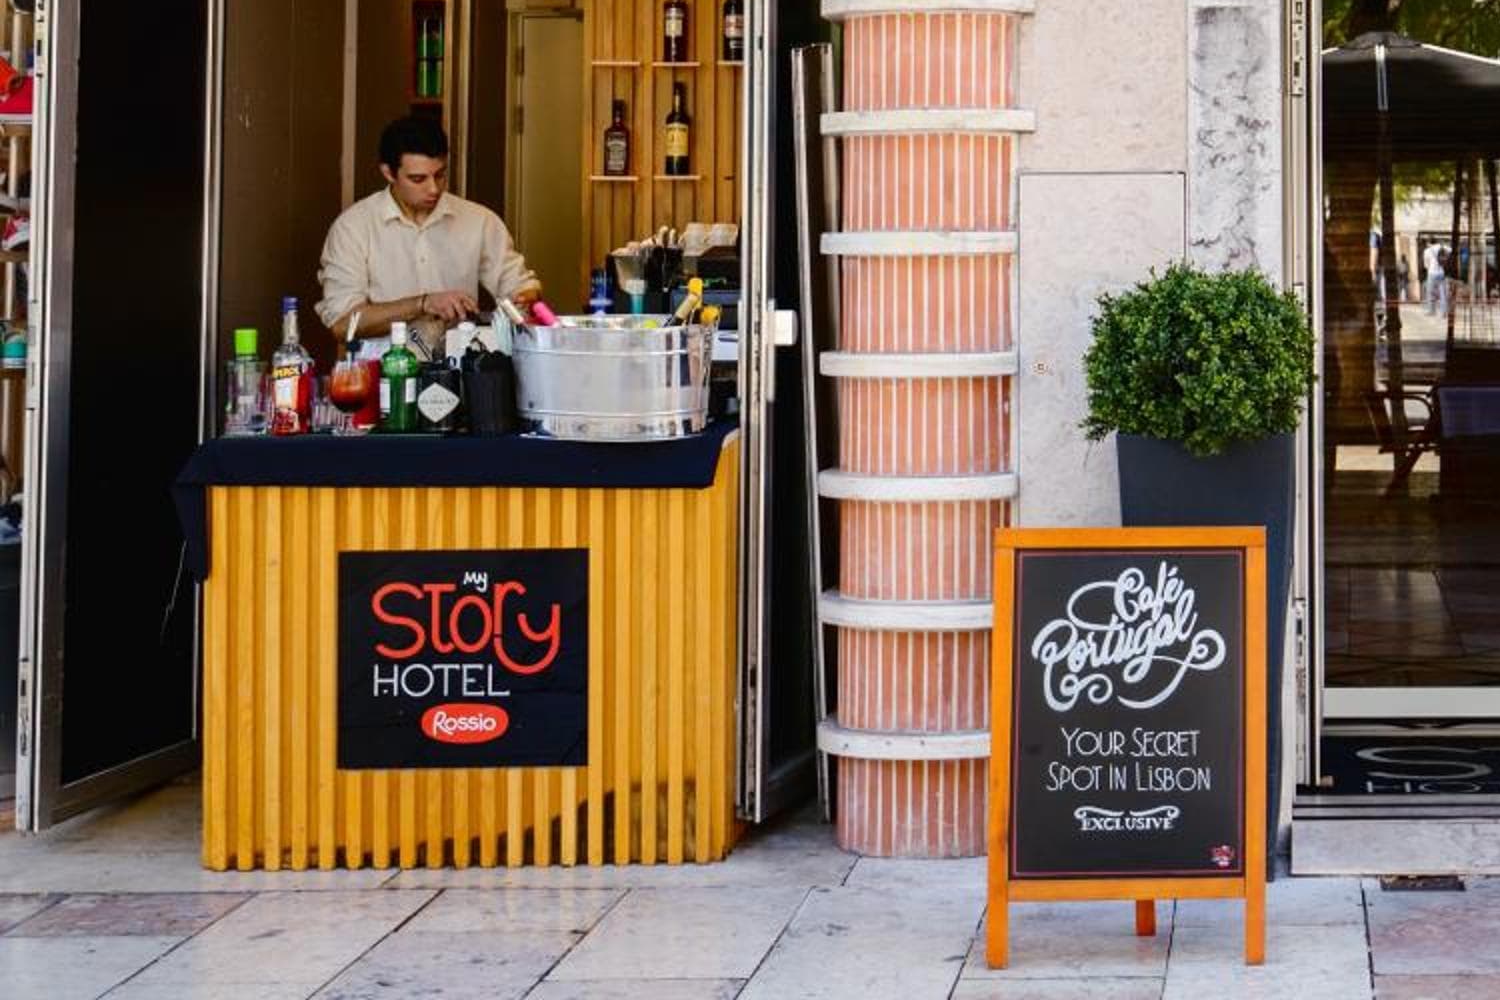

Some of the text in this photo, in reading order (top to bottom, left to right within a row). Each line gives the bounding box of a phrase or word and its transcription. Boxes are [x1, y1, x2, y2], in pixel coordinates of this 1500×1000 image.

[372, 581, 561, 675] Story
[373, 663, 511, 697] HOTEL
[432, 711, 497, 737] Rossio
[1061, 727, 1200, 757] YOUR SECRET
[1046, 762, 1103, 791] SPOT
[1108, 767, 1127, 791] IN
[1080, 816, 1175, 832] EXCLUSIVE
